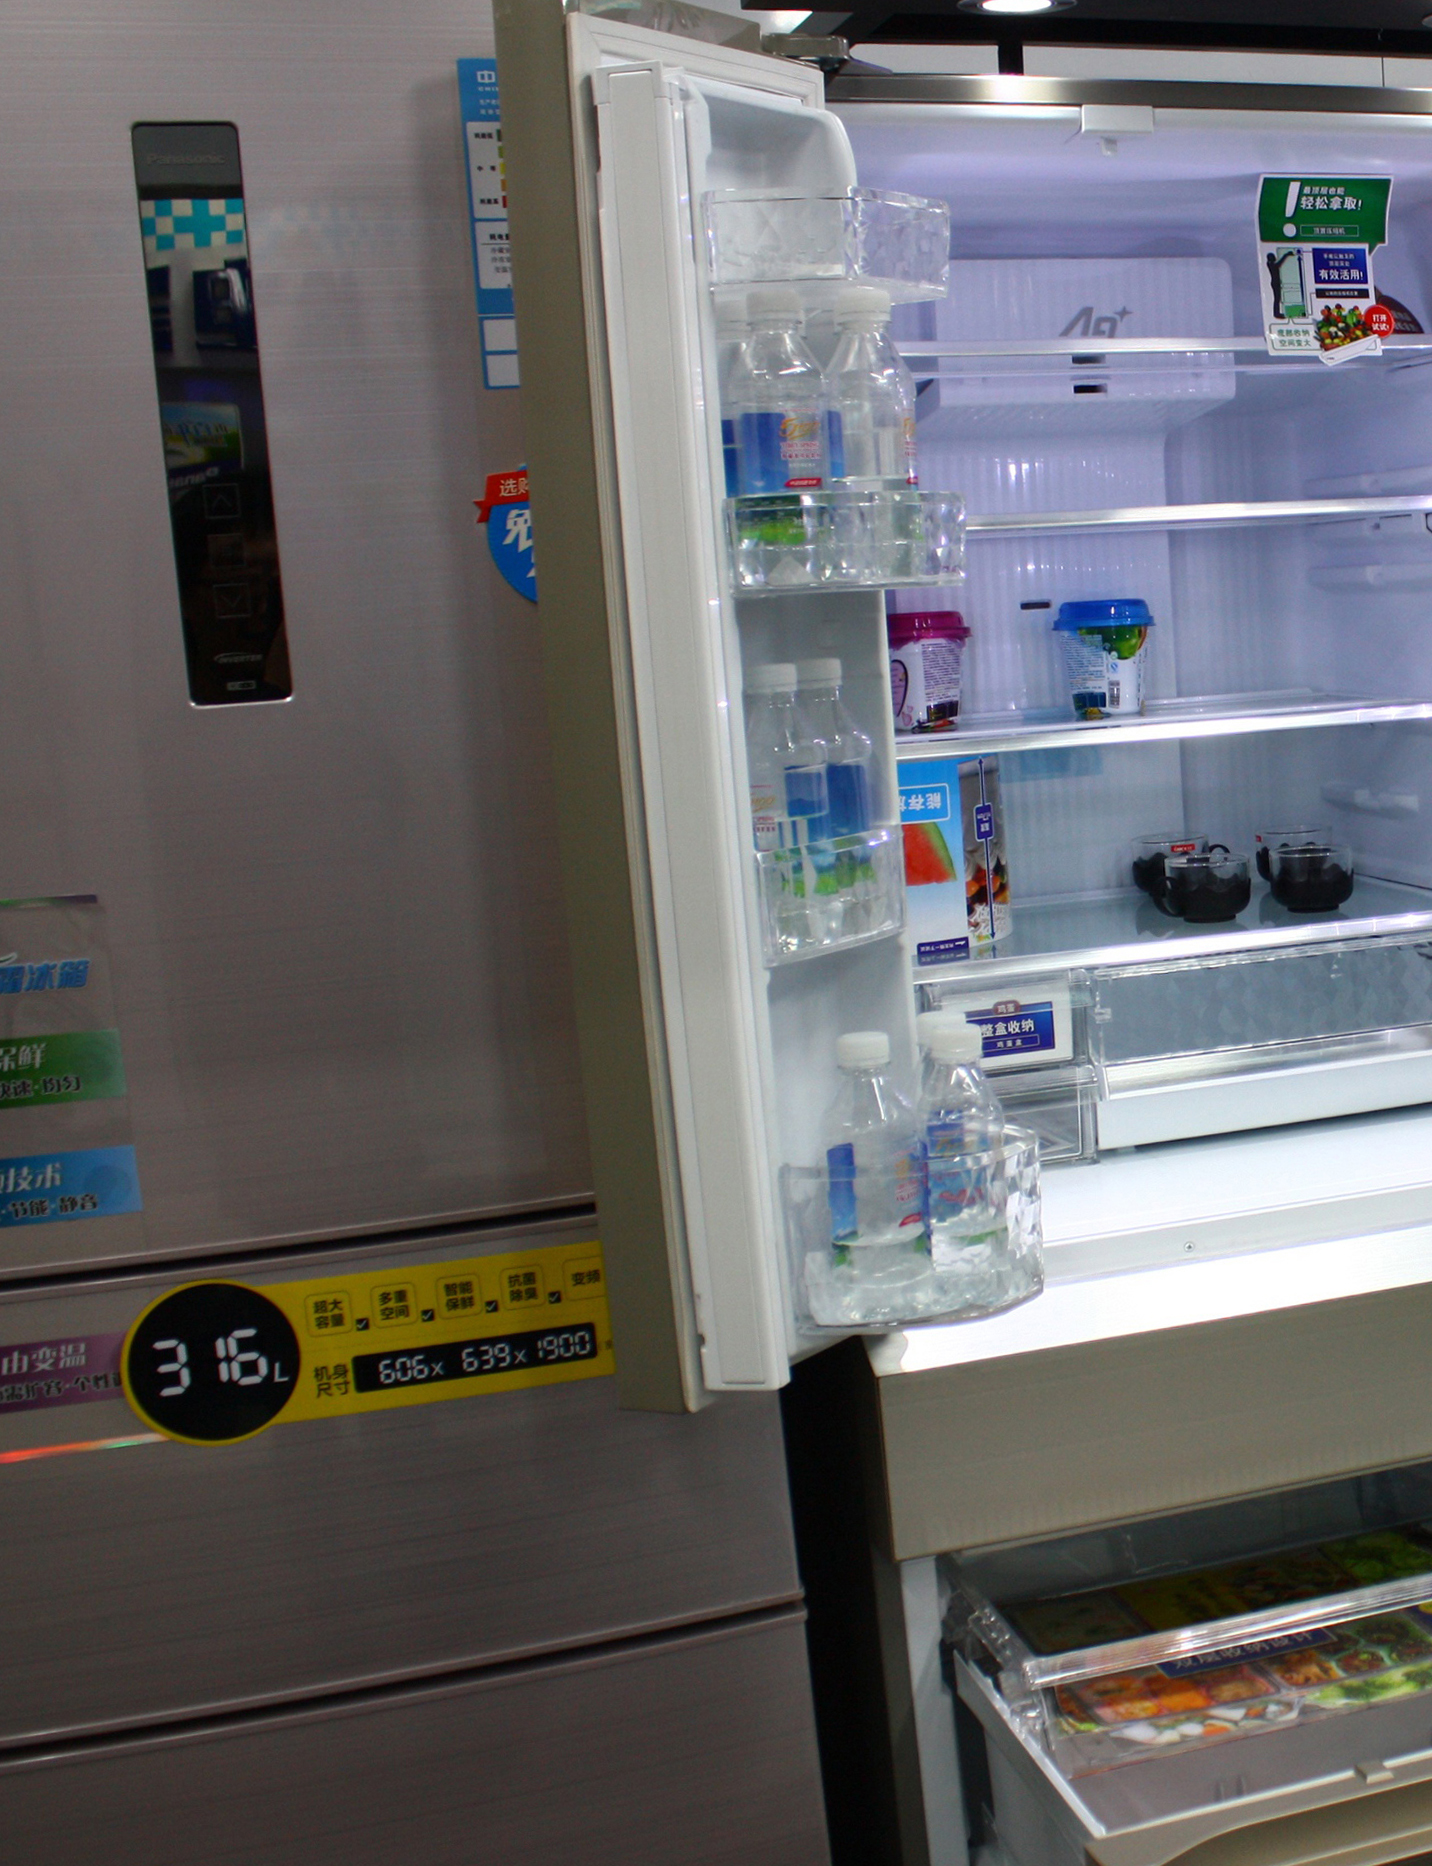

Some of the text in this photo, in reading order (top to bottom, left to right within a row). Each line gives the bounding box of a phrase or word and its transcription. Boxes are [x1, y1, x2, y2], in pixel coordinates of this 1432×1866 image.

[1300, 195, 1363, 211] 轻松拿取!
[1319, 269, 1364, 281] 有效活用!
[1372, 314, 1387, 322] 打开
[507, 1271, 537, 1288] 抗菌
[571, 1269, 600, 1286] 变频
[378, 1289, 407, 1305] 多重
[443, 1280, 473, 1297] 智能
[509, 1286, 538, 1303] 除臭
[313, 1298, 343, 1314] 超大
[380, 1304, 410, 1321] 空间
[445, 1296, 475, 1312] 保鲜
[314, 1314, 345, 1329] 容量
[536, 1330, 592, 1361] 1900
[313, 1364, 349, 1381] 机身
[316, 1380, 350, 1398] 尺寸
